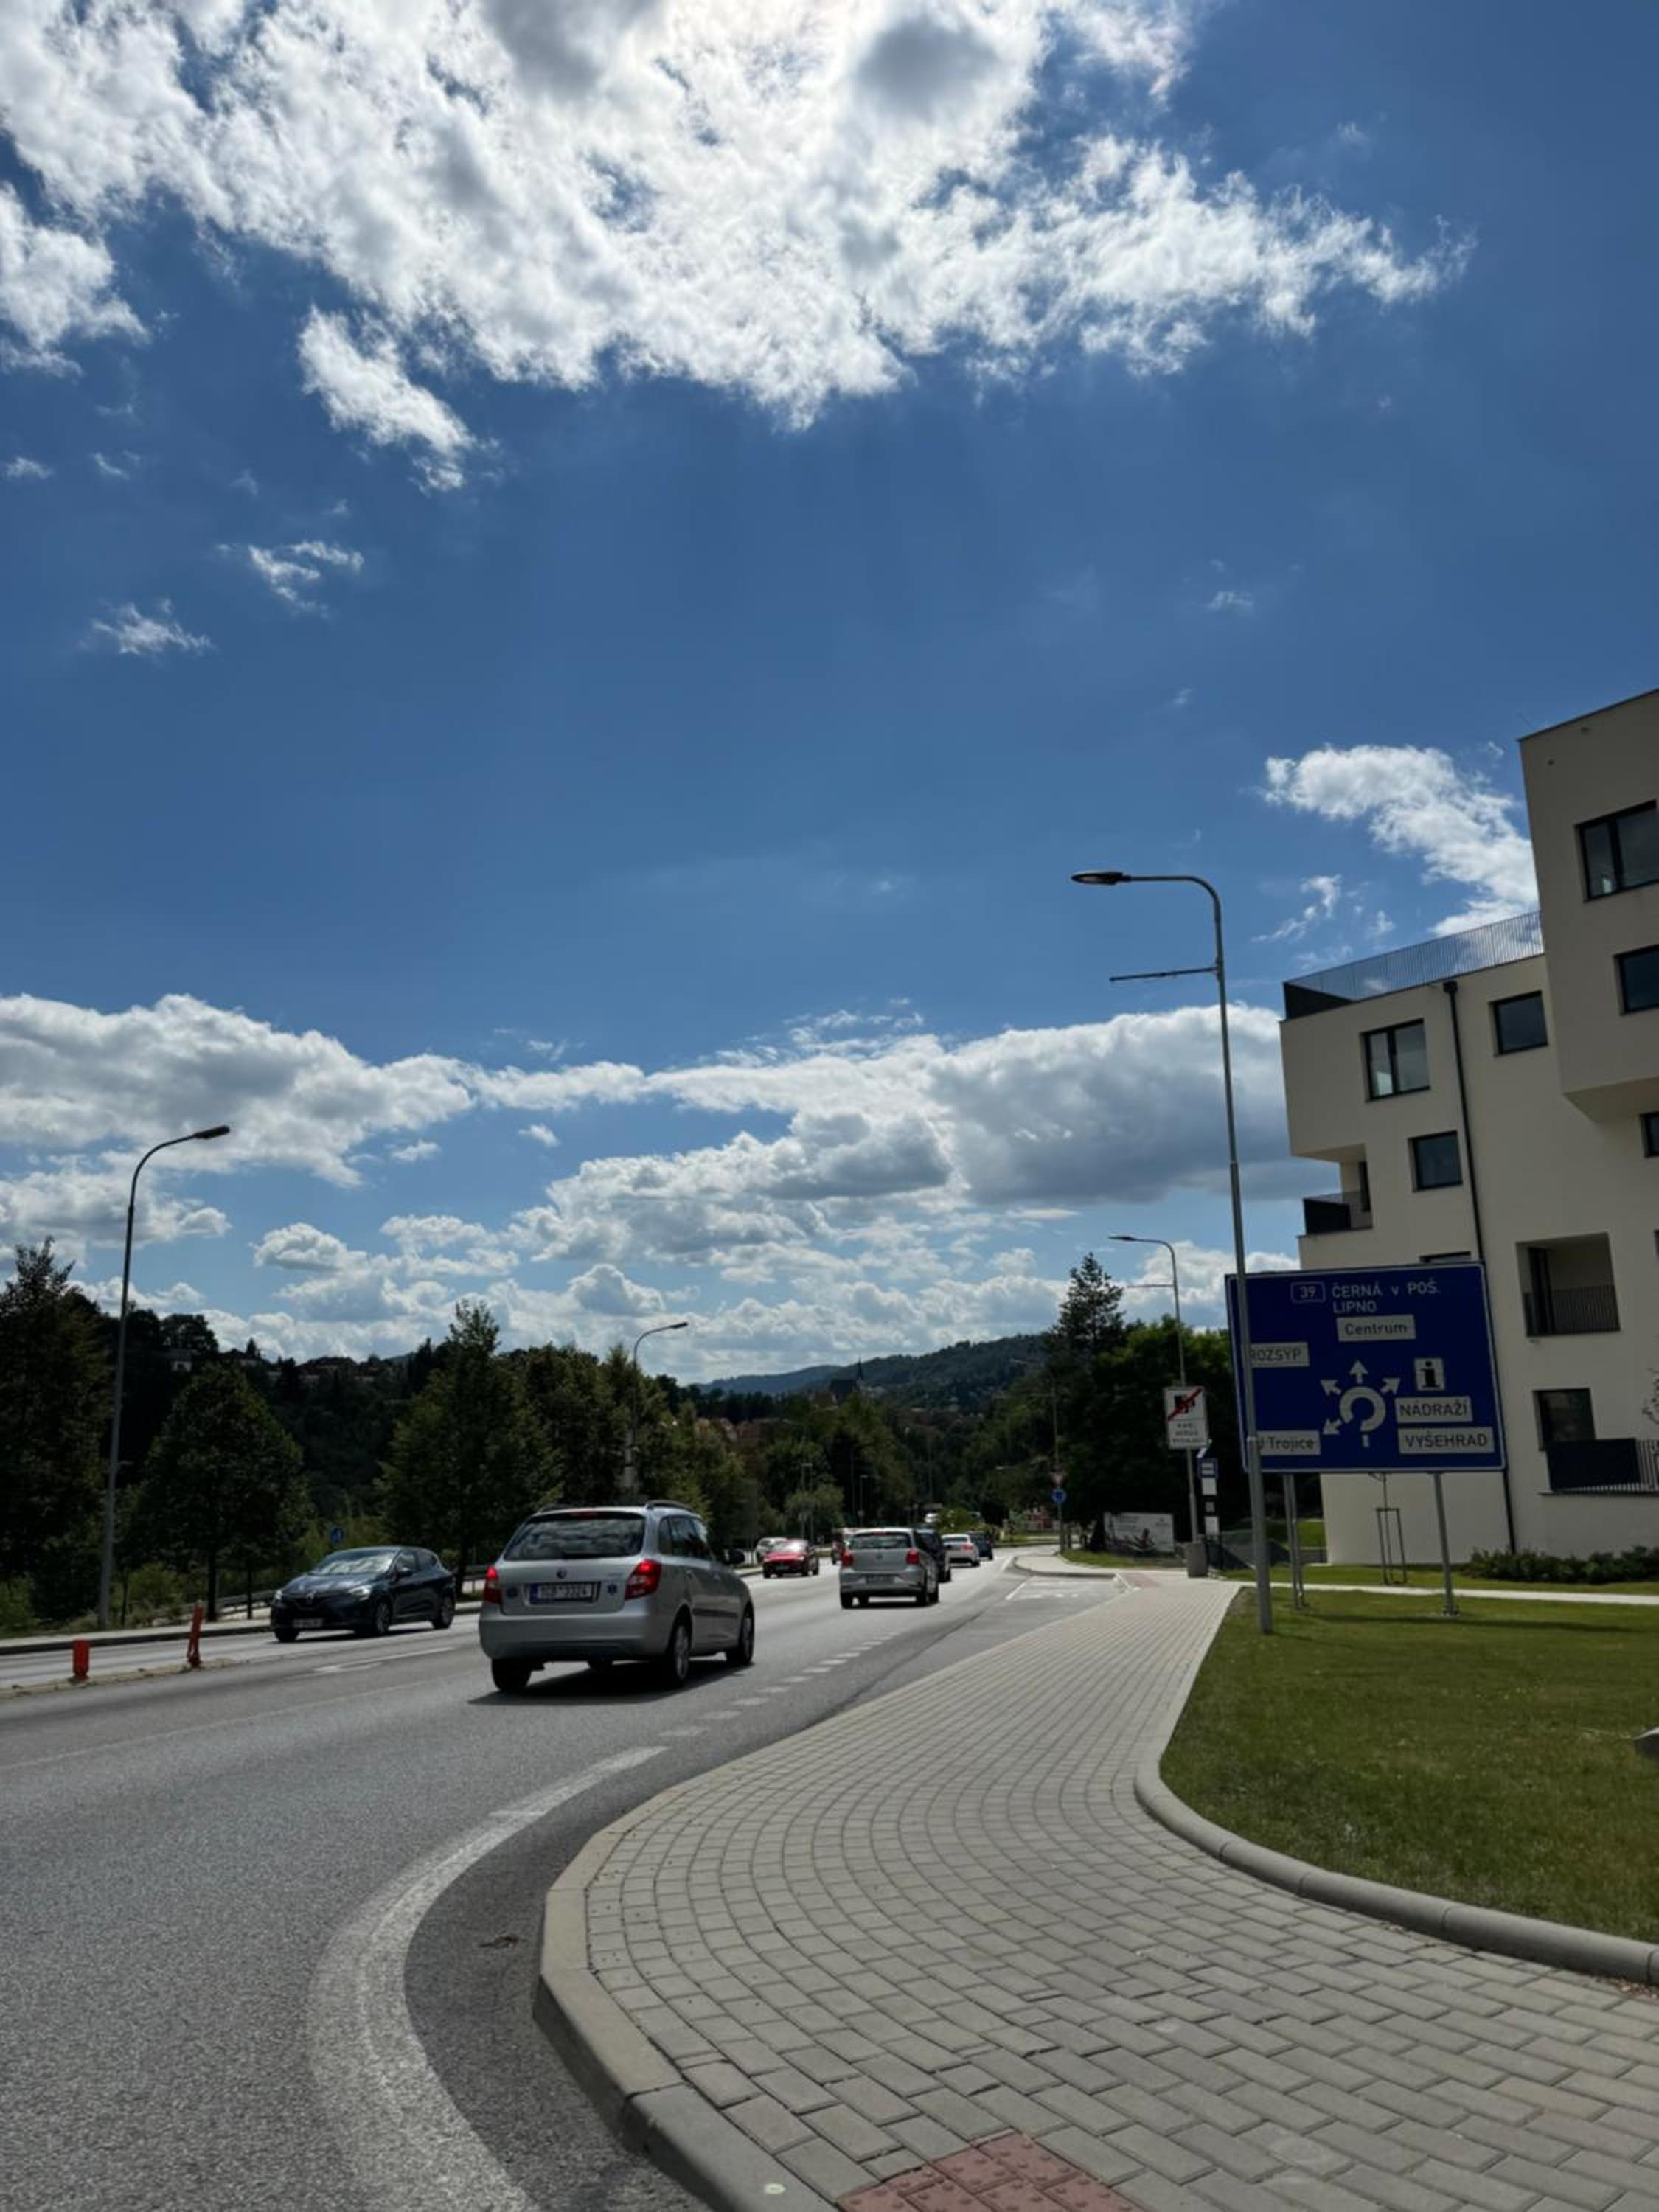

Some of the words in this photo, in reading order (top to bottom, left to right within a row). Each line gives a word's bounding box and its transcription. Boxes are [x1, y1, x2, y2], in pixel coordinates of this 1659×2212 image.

[1299, 1286, 1316, 1298] 39
[1332, 1281, 1382, 1298] ČERNÁ
[1391, 1286, 1399, 1296] v
[1332, 1300, 1377, 1314] LIPNO
[1344, 1322, 1408, 1335] Centrum
[1399, 1399, 1467, 1416] NÁDRAŽÍ
[1267, 1436, 1315, 1452] Trojice
[1405, 1431, 1488, 1448] VYŠEHRAD
